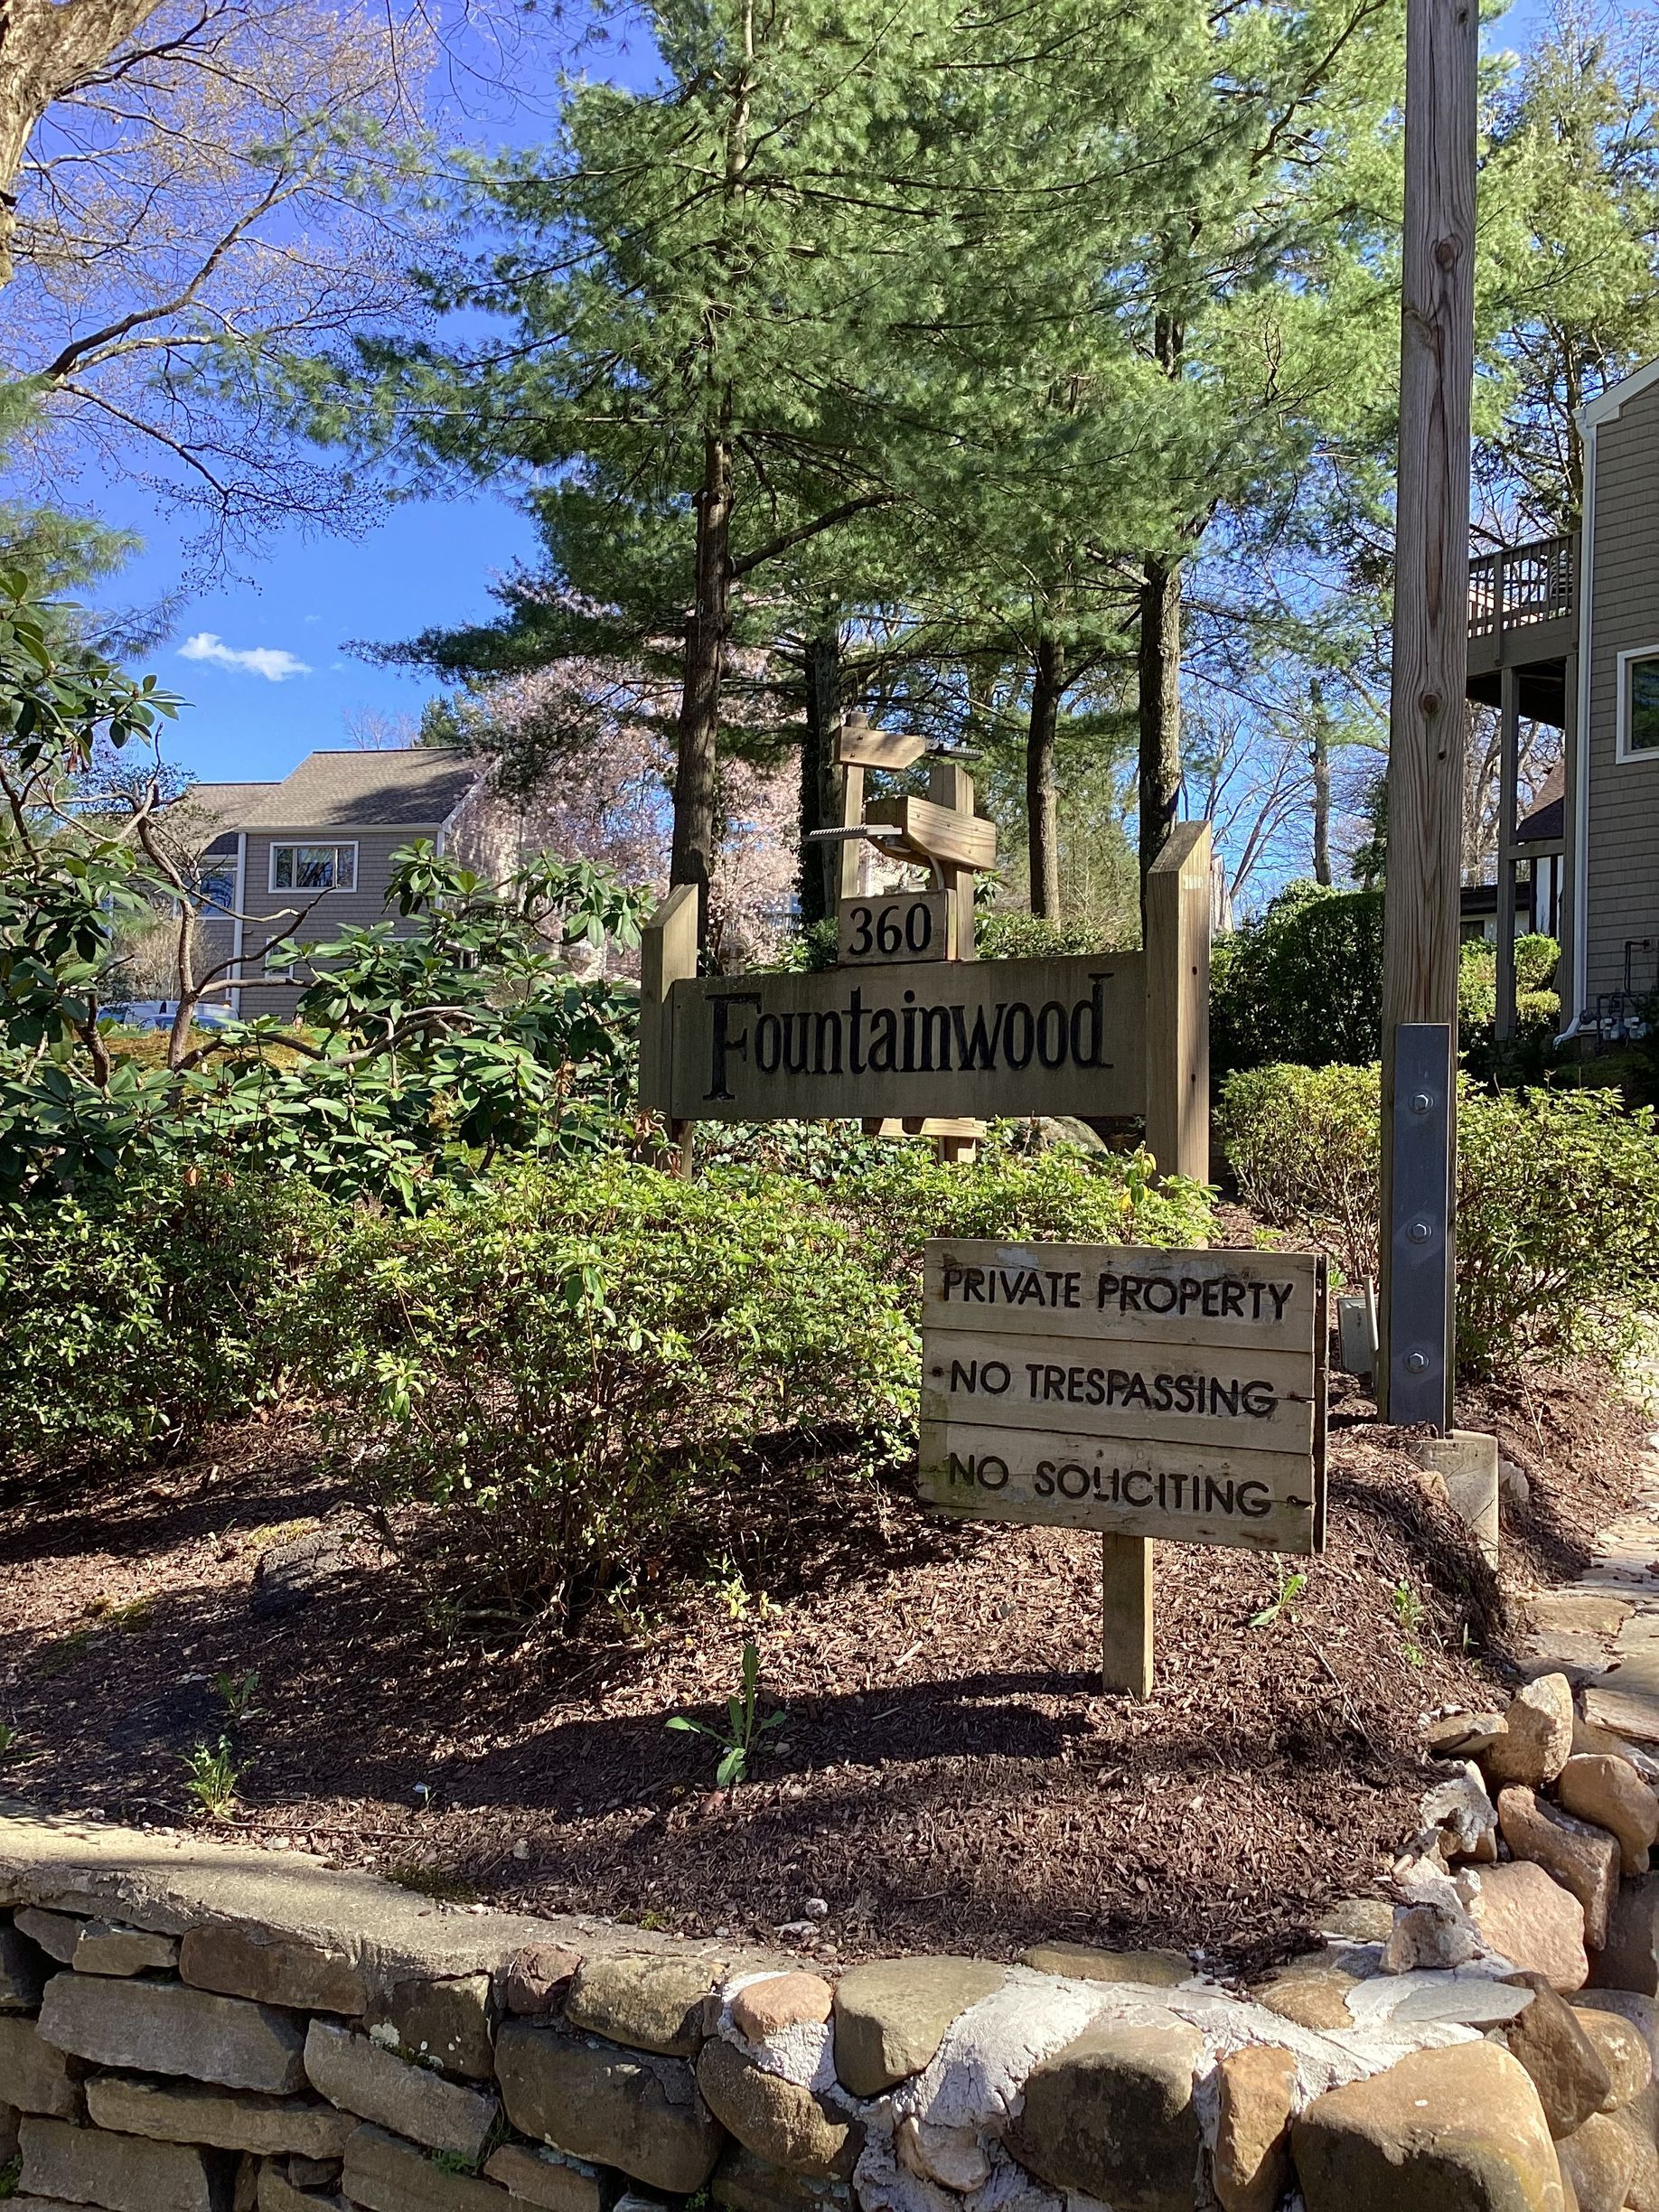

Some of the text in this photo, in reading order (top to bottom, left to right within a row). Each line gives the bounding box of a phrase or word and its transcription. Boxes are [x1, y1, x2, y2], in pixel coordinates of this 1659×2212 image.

[848, 902, 933, 957] 360
[702, 972, 1116, 1101] Fountainwood
[942, 1267, 1294, 1321] PRIVATE PROPERTY
[950, 1358, 1279, 1419] NO TRESPASSING
[948, 1452, 1272, 1518] NO SOLICITING
